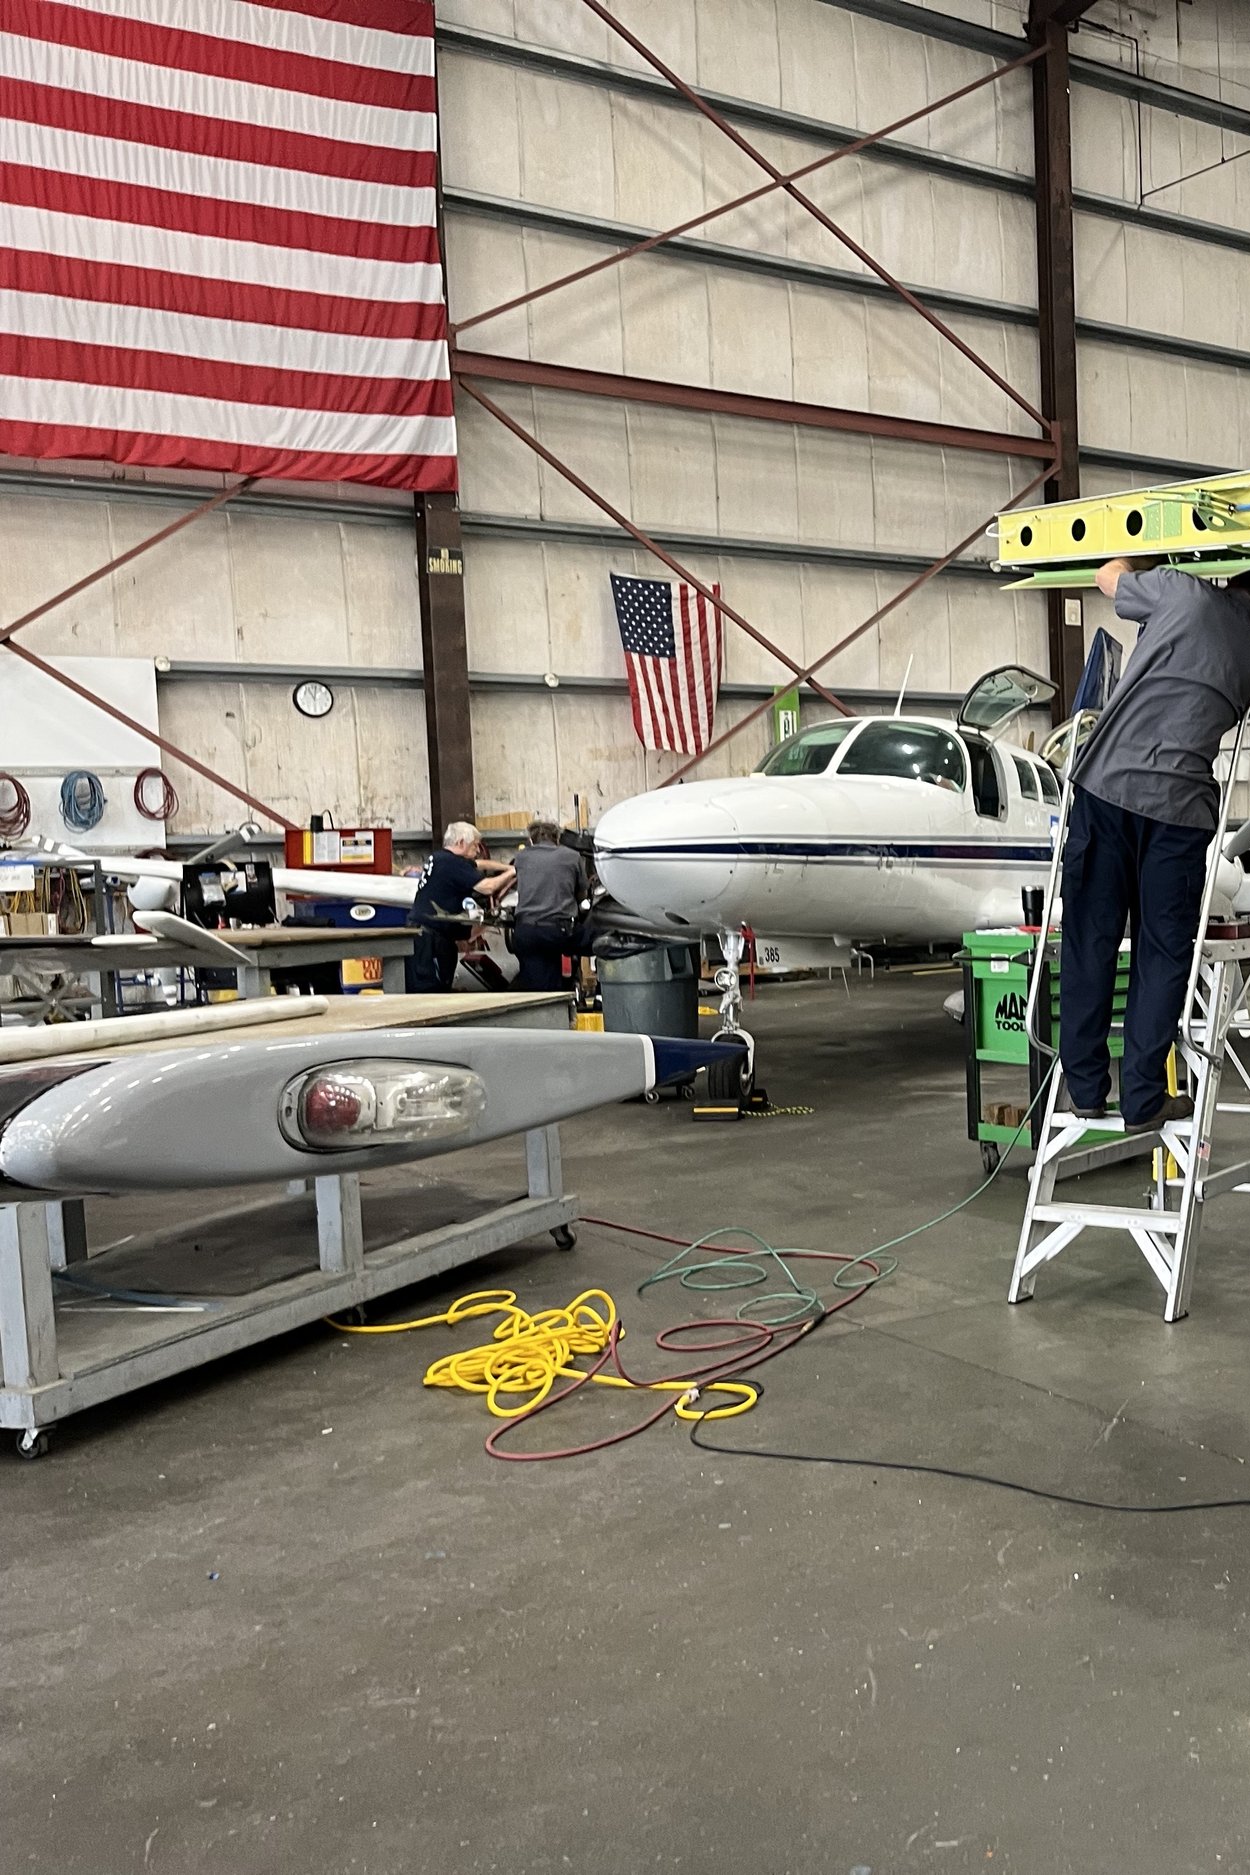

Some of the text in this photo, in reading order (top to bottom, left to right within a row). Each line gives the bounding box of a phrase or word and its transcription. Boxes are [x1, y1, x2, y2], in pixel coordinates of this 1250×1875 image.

[428, 557, 463, 574] SMOKING
[764, 946, 780, 963] 385
[995, 1020, 1027, 1032] TOOL
